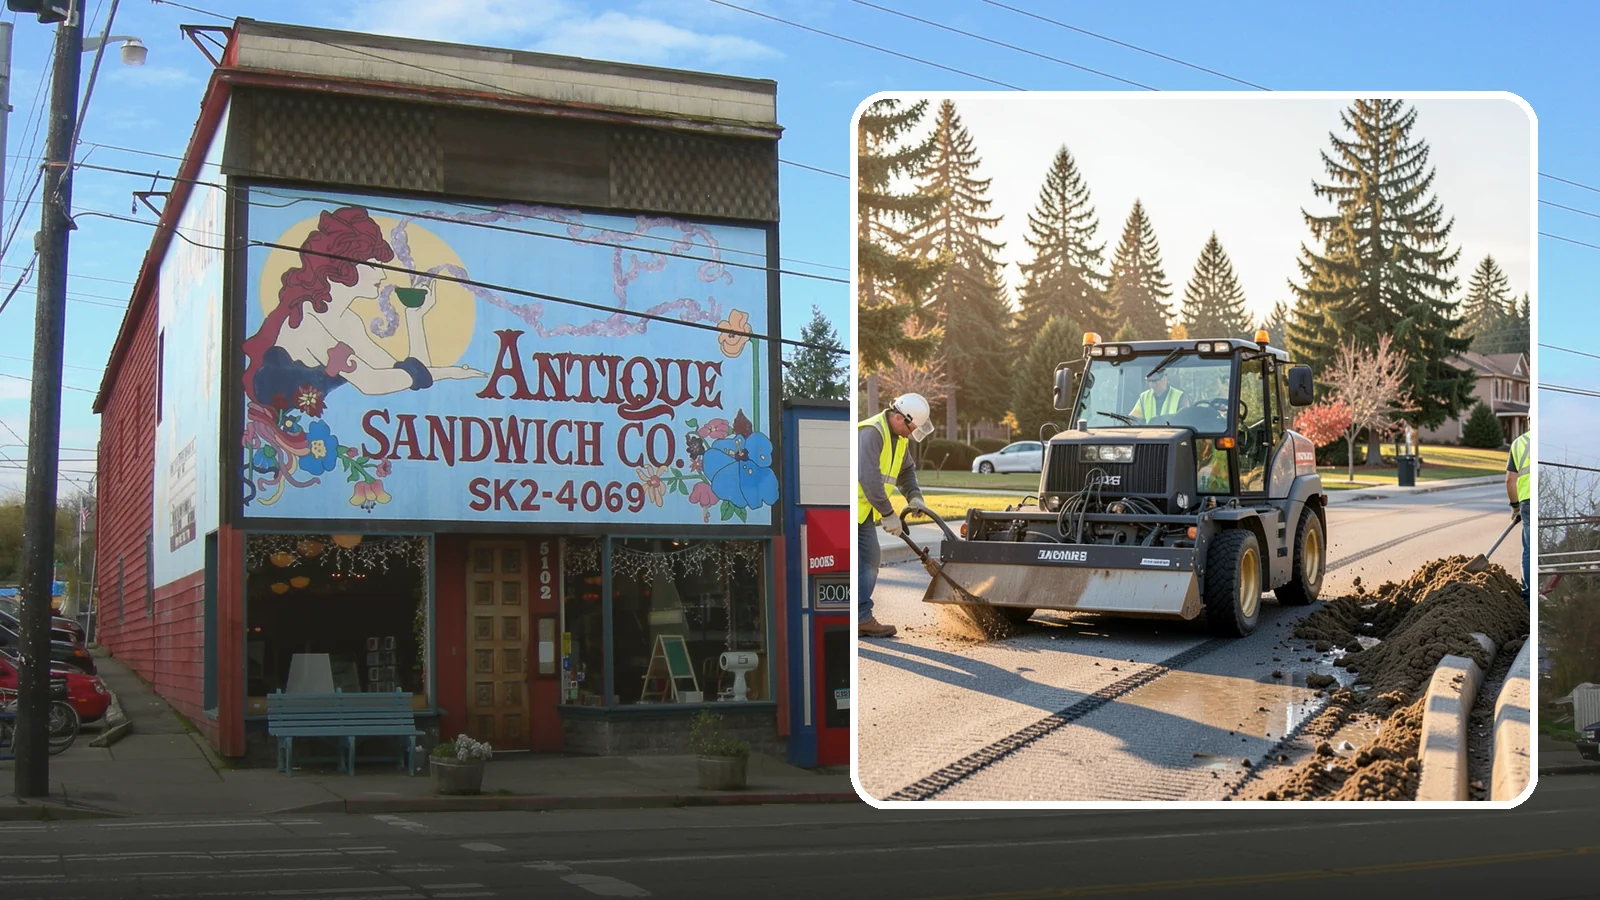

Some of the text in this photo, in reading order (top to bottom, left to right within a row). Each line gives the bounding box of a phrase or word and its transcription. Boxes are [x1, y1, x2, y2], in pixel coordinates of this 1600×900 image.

[475, 329, 723, 420] ANTIQUE
[361, 408, 685, 468] SANDWICH CO.
[468, 477, 645, 512] SK2-4069
[540, 542, 552, 600] 5102
[809, 555, 835, 569] BOOKS
